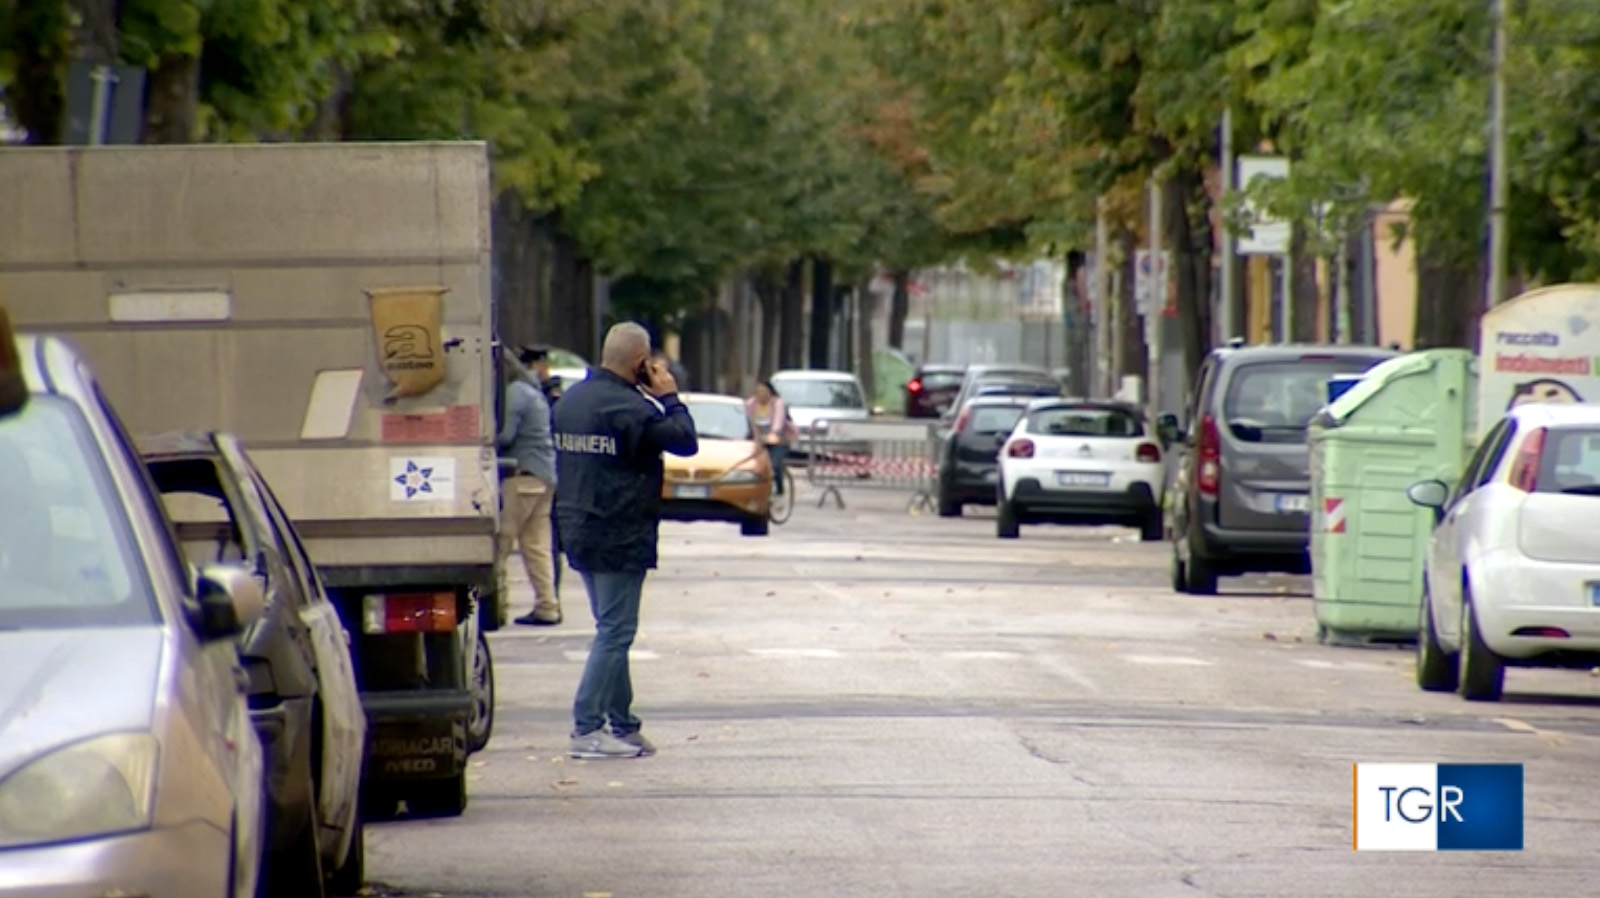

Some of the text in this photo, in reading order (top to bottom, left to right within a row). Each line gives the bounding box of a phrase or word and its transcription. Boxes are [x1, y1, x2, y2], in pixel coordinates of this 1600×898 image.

[1496, 332, 1559, 347] raccolta
[1495, 352, 1590, 376] indumenti
[384, 758, 436, 773] IVECO
